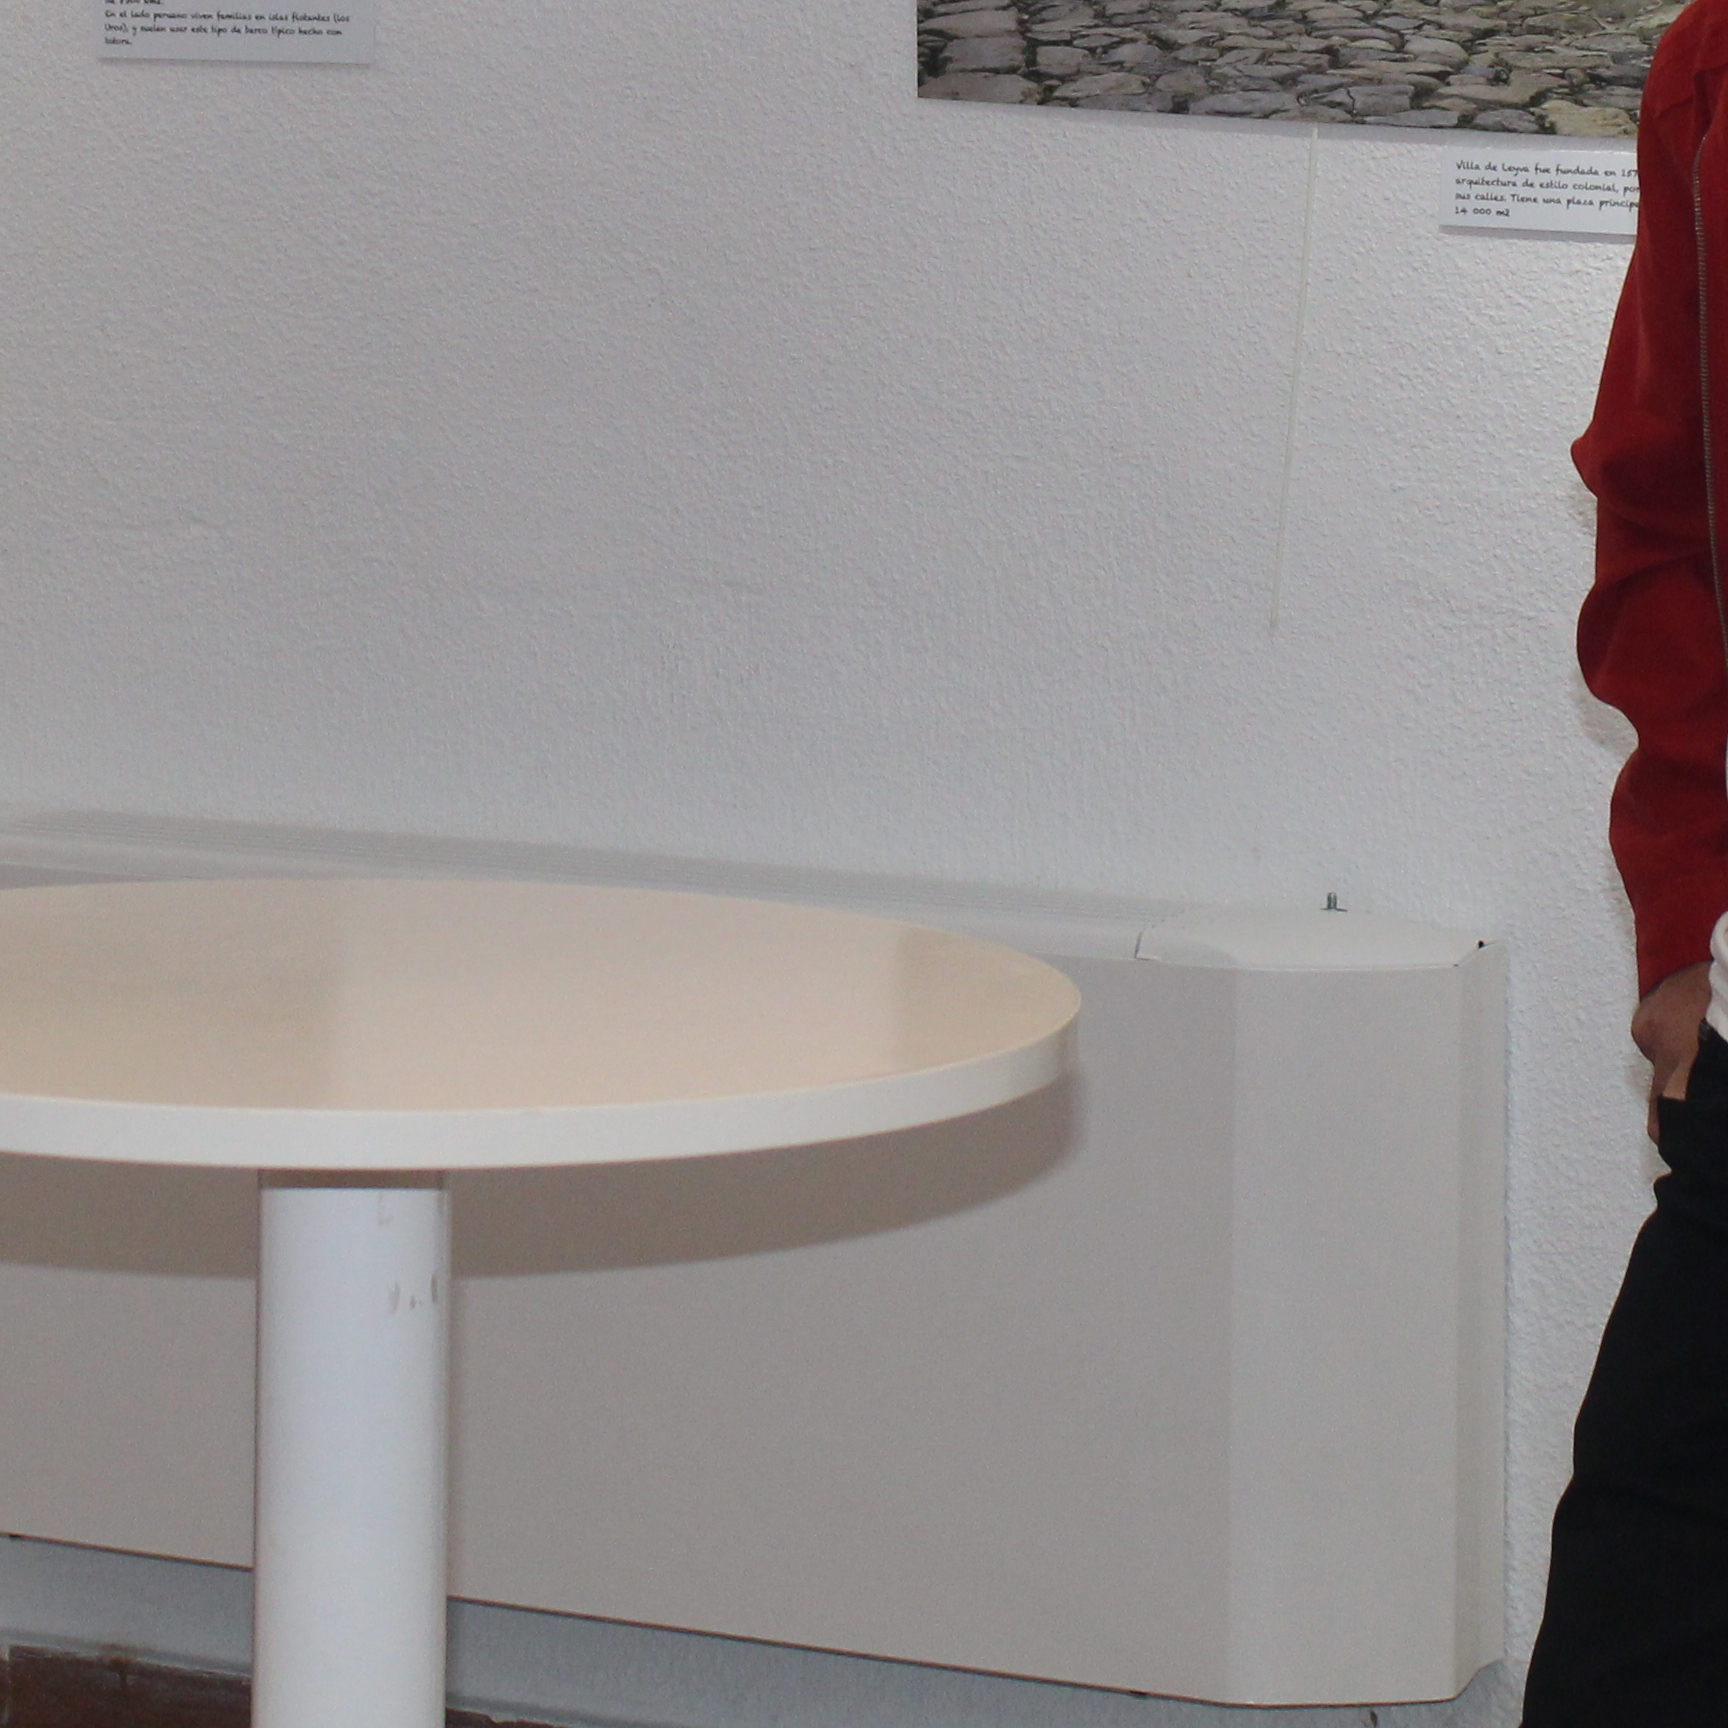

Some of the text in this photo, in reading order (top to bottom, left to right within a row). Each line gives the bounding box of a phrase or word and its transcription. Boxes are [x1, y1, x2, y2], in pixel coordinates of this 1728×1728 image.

[154, 12, 187, 21] peruano
[217, 10, 252, 21] familias
[292, 12, 330, 21] flotantes
[132, 27, 137, 36] y
[211, 26, 227, 36] tipo
[231, 26, 241, 34] de
[245, 25, 267, 34] barco
[299, 27, 323, 35] hecho
[1456, 160, 1480, 171] Villa
[1485, 162, 1497, 172] de
[1535, 163, 1551, 174] fue
[1556, 165, 1600, 176] fundada
[1455, 176, 1517, 190] arquitectura
[1522, 178, 1534, 188] de
[1540, 180, 1568, 189] estilo
[1573, 181, 1619, 193] colonial,
[1475, 192, 1506, 201] calles.
[1511, 194, 1537, 203] Tiene
[1567, 196, 1593, 209] plaza
